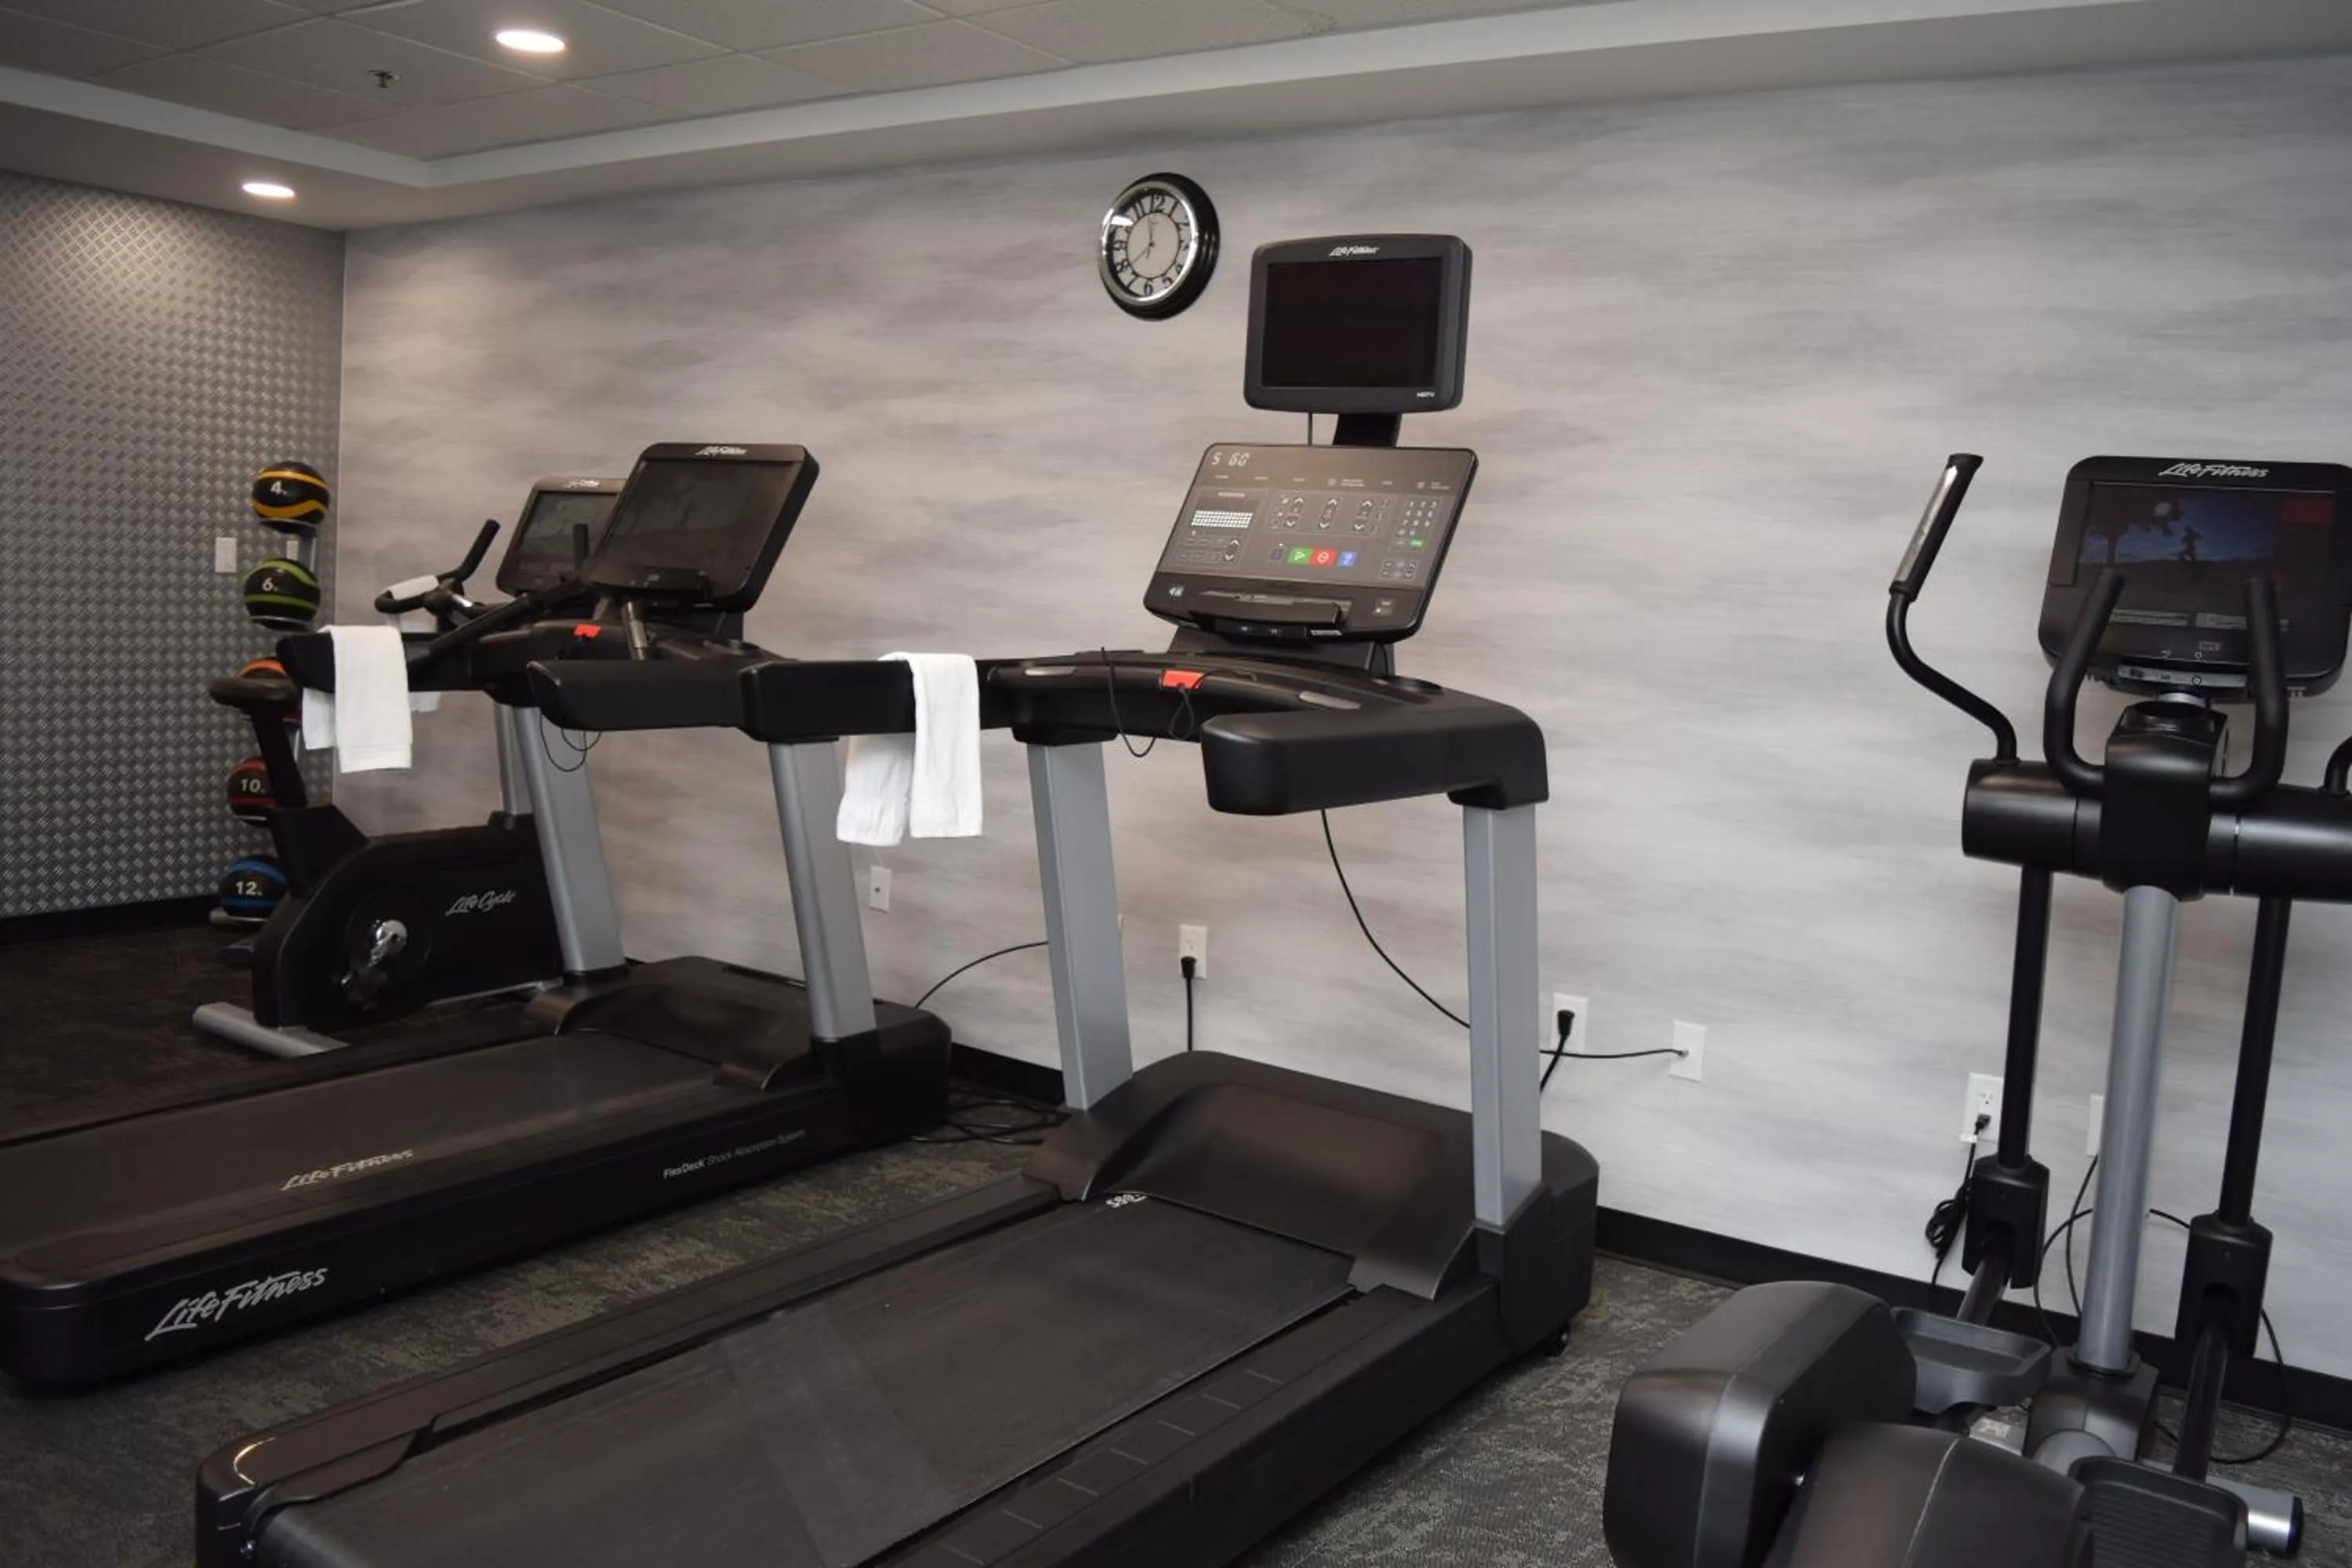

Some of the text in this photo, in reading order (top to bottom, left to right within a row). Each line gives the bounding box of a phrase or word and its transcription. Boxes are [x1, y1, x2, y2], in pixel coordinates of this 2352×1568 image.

[1150, 194, 1165, 213] 12
[1115, 259, 1130, 274] 8
[1143, 279, 1153, 296] 6
[270, 480, 283, 495] 4
[262, 577, 274, 592] 6
[241, 778, 261, 793] 10
[235, 880, 258, 896] 12
